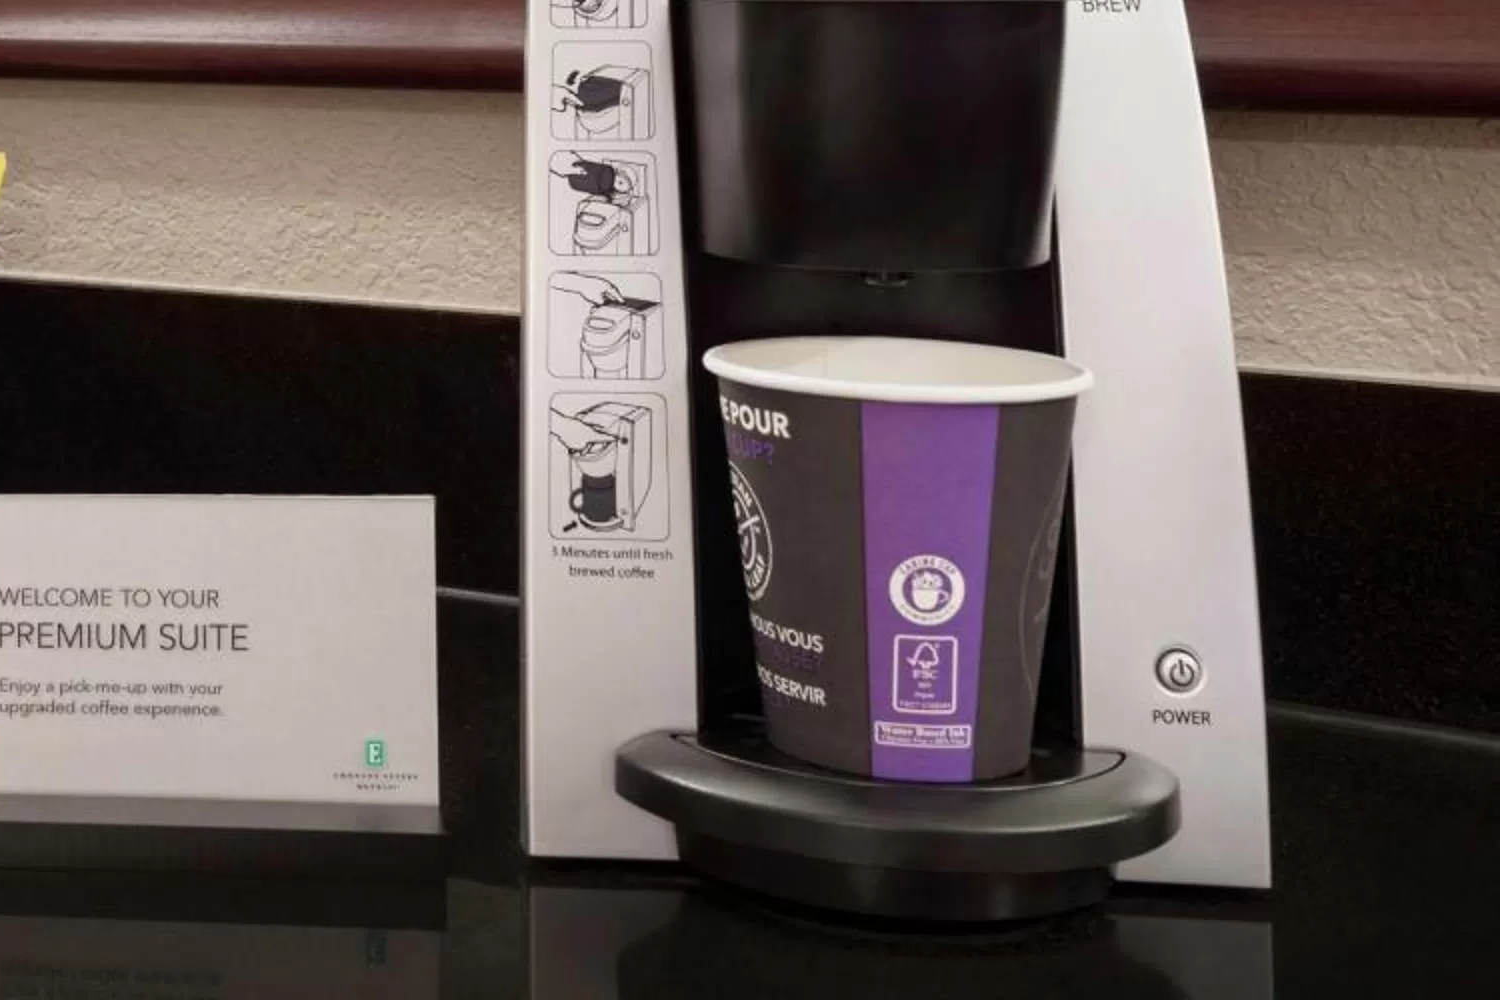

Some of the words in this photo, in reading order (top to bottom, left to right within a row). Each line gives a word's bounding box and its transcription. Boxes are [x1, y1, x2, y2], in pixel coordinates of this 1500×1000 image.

[729, 400, 791, 439] POUR
[561, 545, 610, 559] Minutes
[613, 547, 641, 560] until
[643, 547, 674, 560] fresh
[569, 564, 615, 577] brewed
[617, 565, 655, 579] coffee
[118, 588, 151, 608] TO
[158, 588, 220, 609] YOUR
[159, 623, 250, 652] SUITE
[775, 623, 825, 654] VOUS
[0, 677, 41, 696] Enjoy
[46, 683, 55, 693] a
[59, 680, 147, 696] pick-me-up
[151, 682, 184, 695] with
[189, 684, 224, 698] your
[772, 674, 828, 708] SERVIR
[0, 701, 76, 717] upgraded
[80, 700, 129, 716] coffee
[133, 702, 224, 718] experience.
[1152, 709, 1211, 726] POWER
